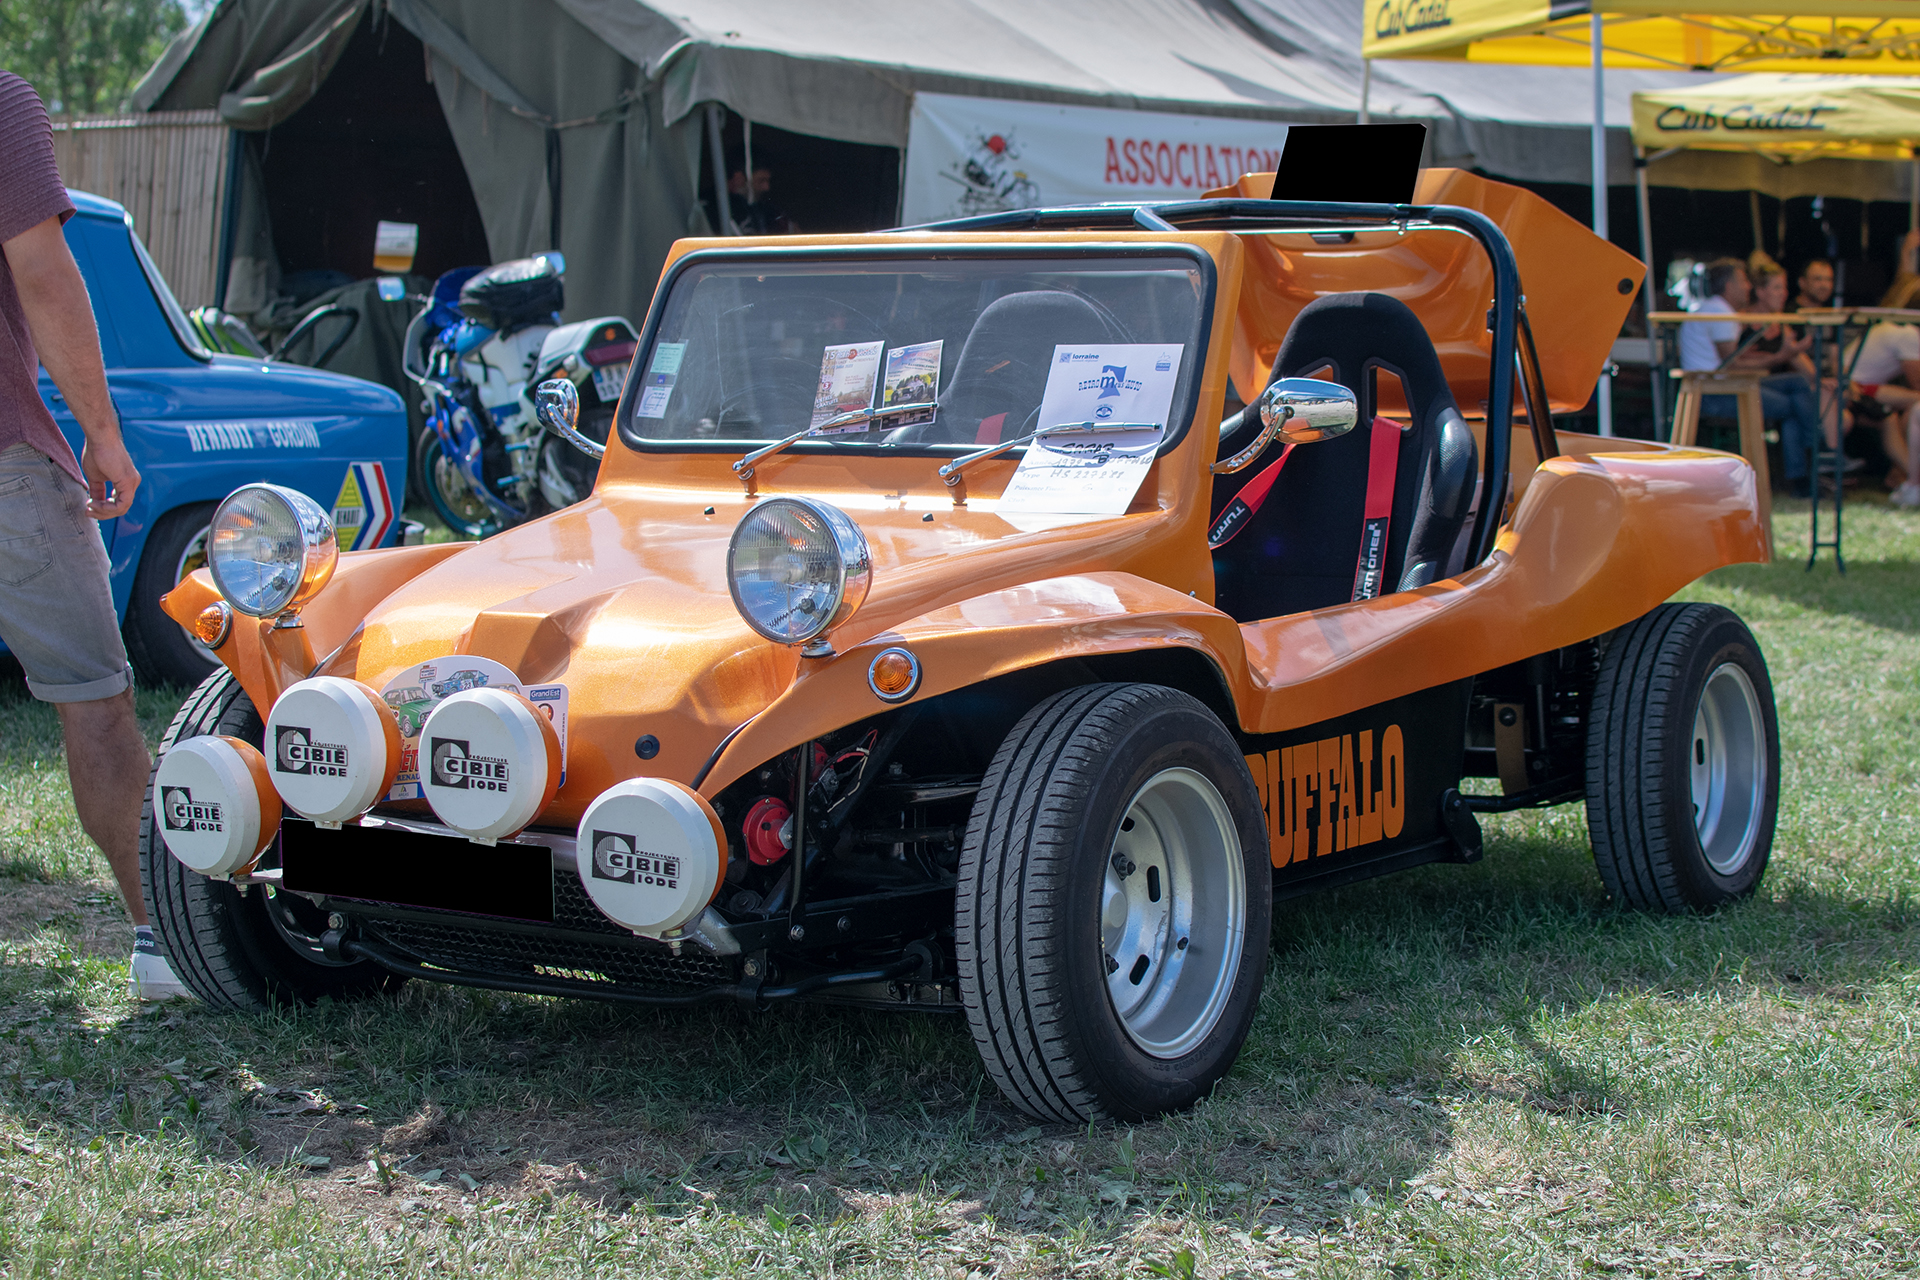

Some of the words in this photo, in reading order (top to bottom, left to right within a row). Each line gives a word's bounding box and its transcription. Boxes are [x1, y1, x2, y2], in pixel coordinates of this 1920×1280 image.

[1656, 104, 1718, 130] Cub
[1722, 104, 1838, 130] Cadet
[185, 423, 254, 452] RENAULT
[267, 421, 321, 448] GORDINI
[336, 509, 360, 526] RENAULT
[1211, 505, 1245, 541] TURN
[1367, 536, 1380, 569] ONE
[1362, 571, 1375, 599] URN
[463, 682, 471, 690] 23
[530, 690, 550, 698] Grand
[550, 689, 560, 697] Est
[468, 754, 507, 763] PROJECTEURS
[312, 765, 347, 777] IODE
[397, 773, 420, 781] RENAU
[470, 779, 507, 792] IODE
[1244, 724, 1405, 869] UFFALO
[196, 821, 222, 832] IODE
[635, 850, 680, 861] PROJECTEURS
[637, 874, 677, 889] IODE
